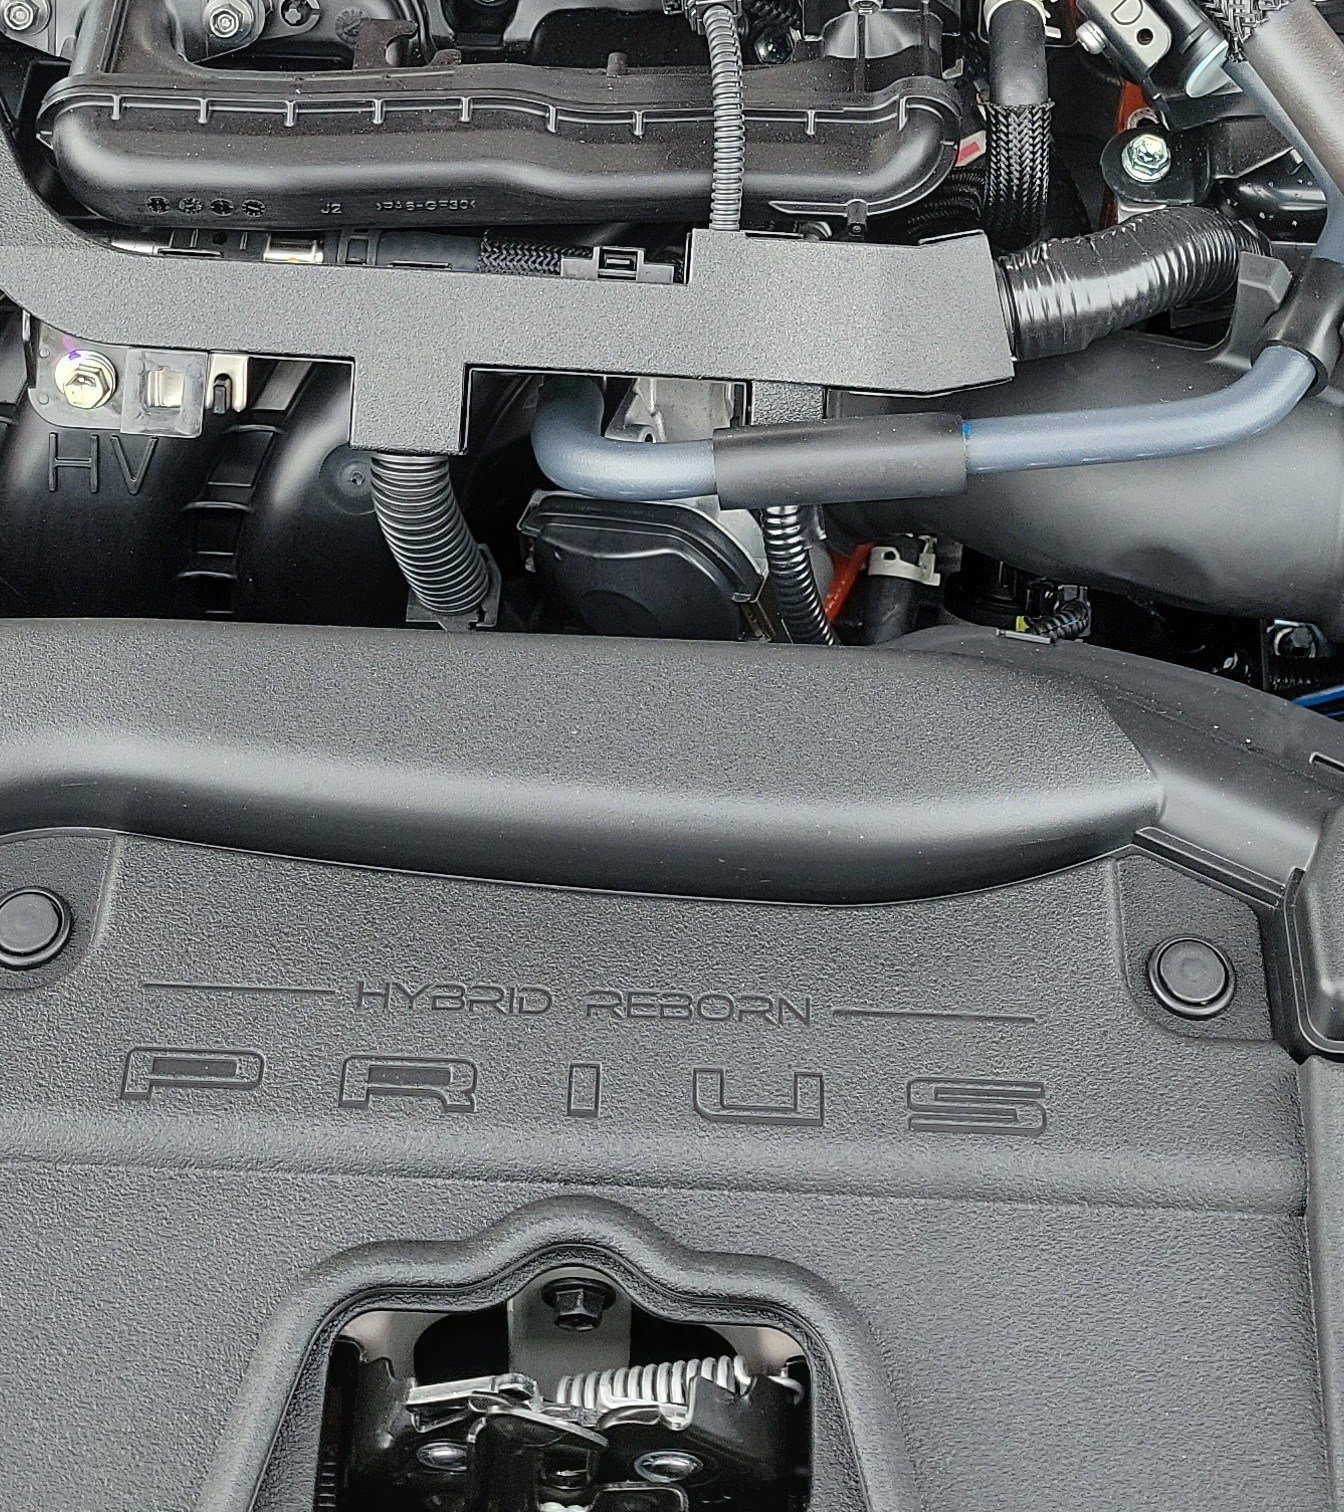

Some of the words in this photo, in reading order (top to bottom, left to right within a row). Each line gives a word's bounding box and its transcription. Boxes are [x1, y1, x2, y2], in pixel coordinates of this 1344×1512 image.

[47, 432, 160, 495] HV
[354, 979, 554, 1018] HYBRID
[584, 990, 814, 1027] REBORN
[120, 1044, 1048, 1137] PRIUS
